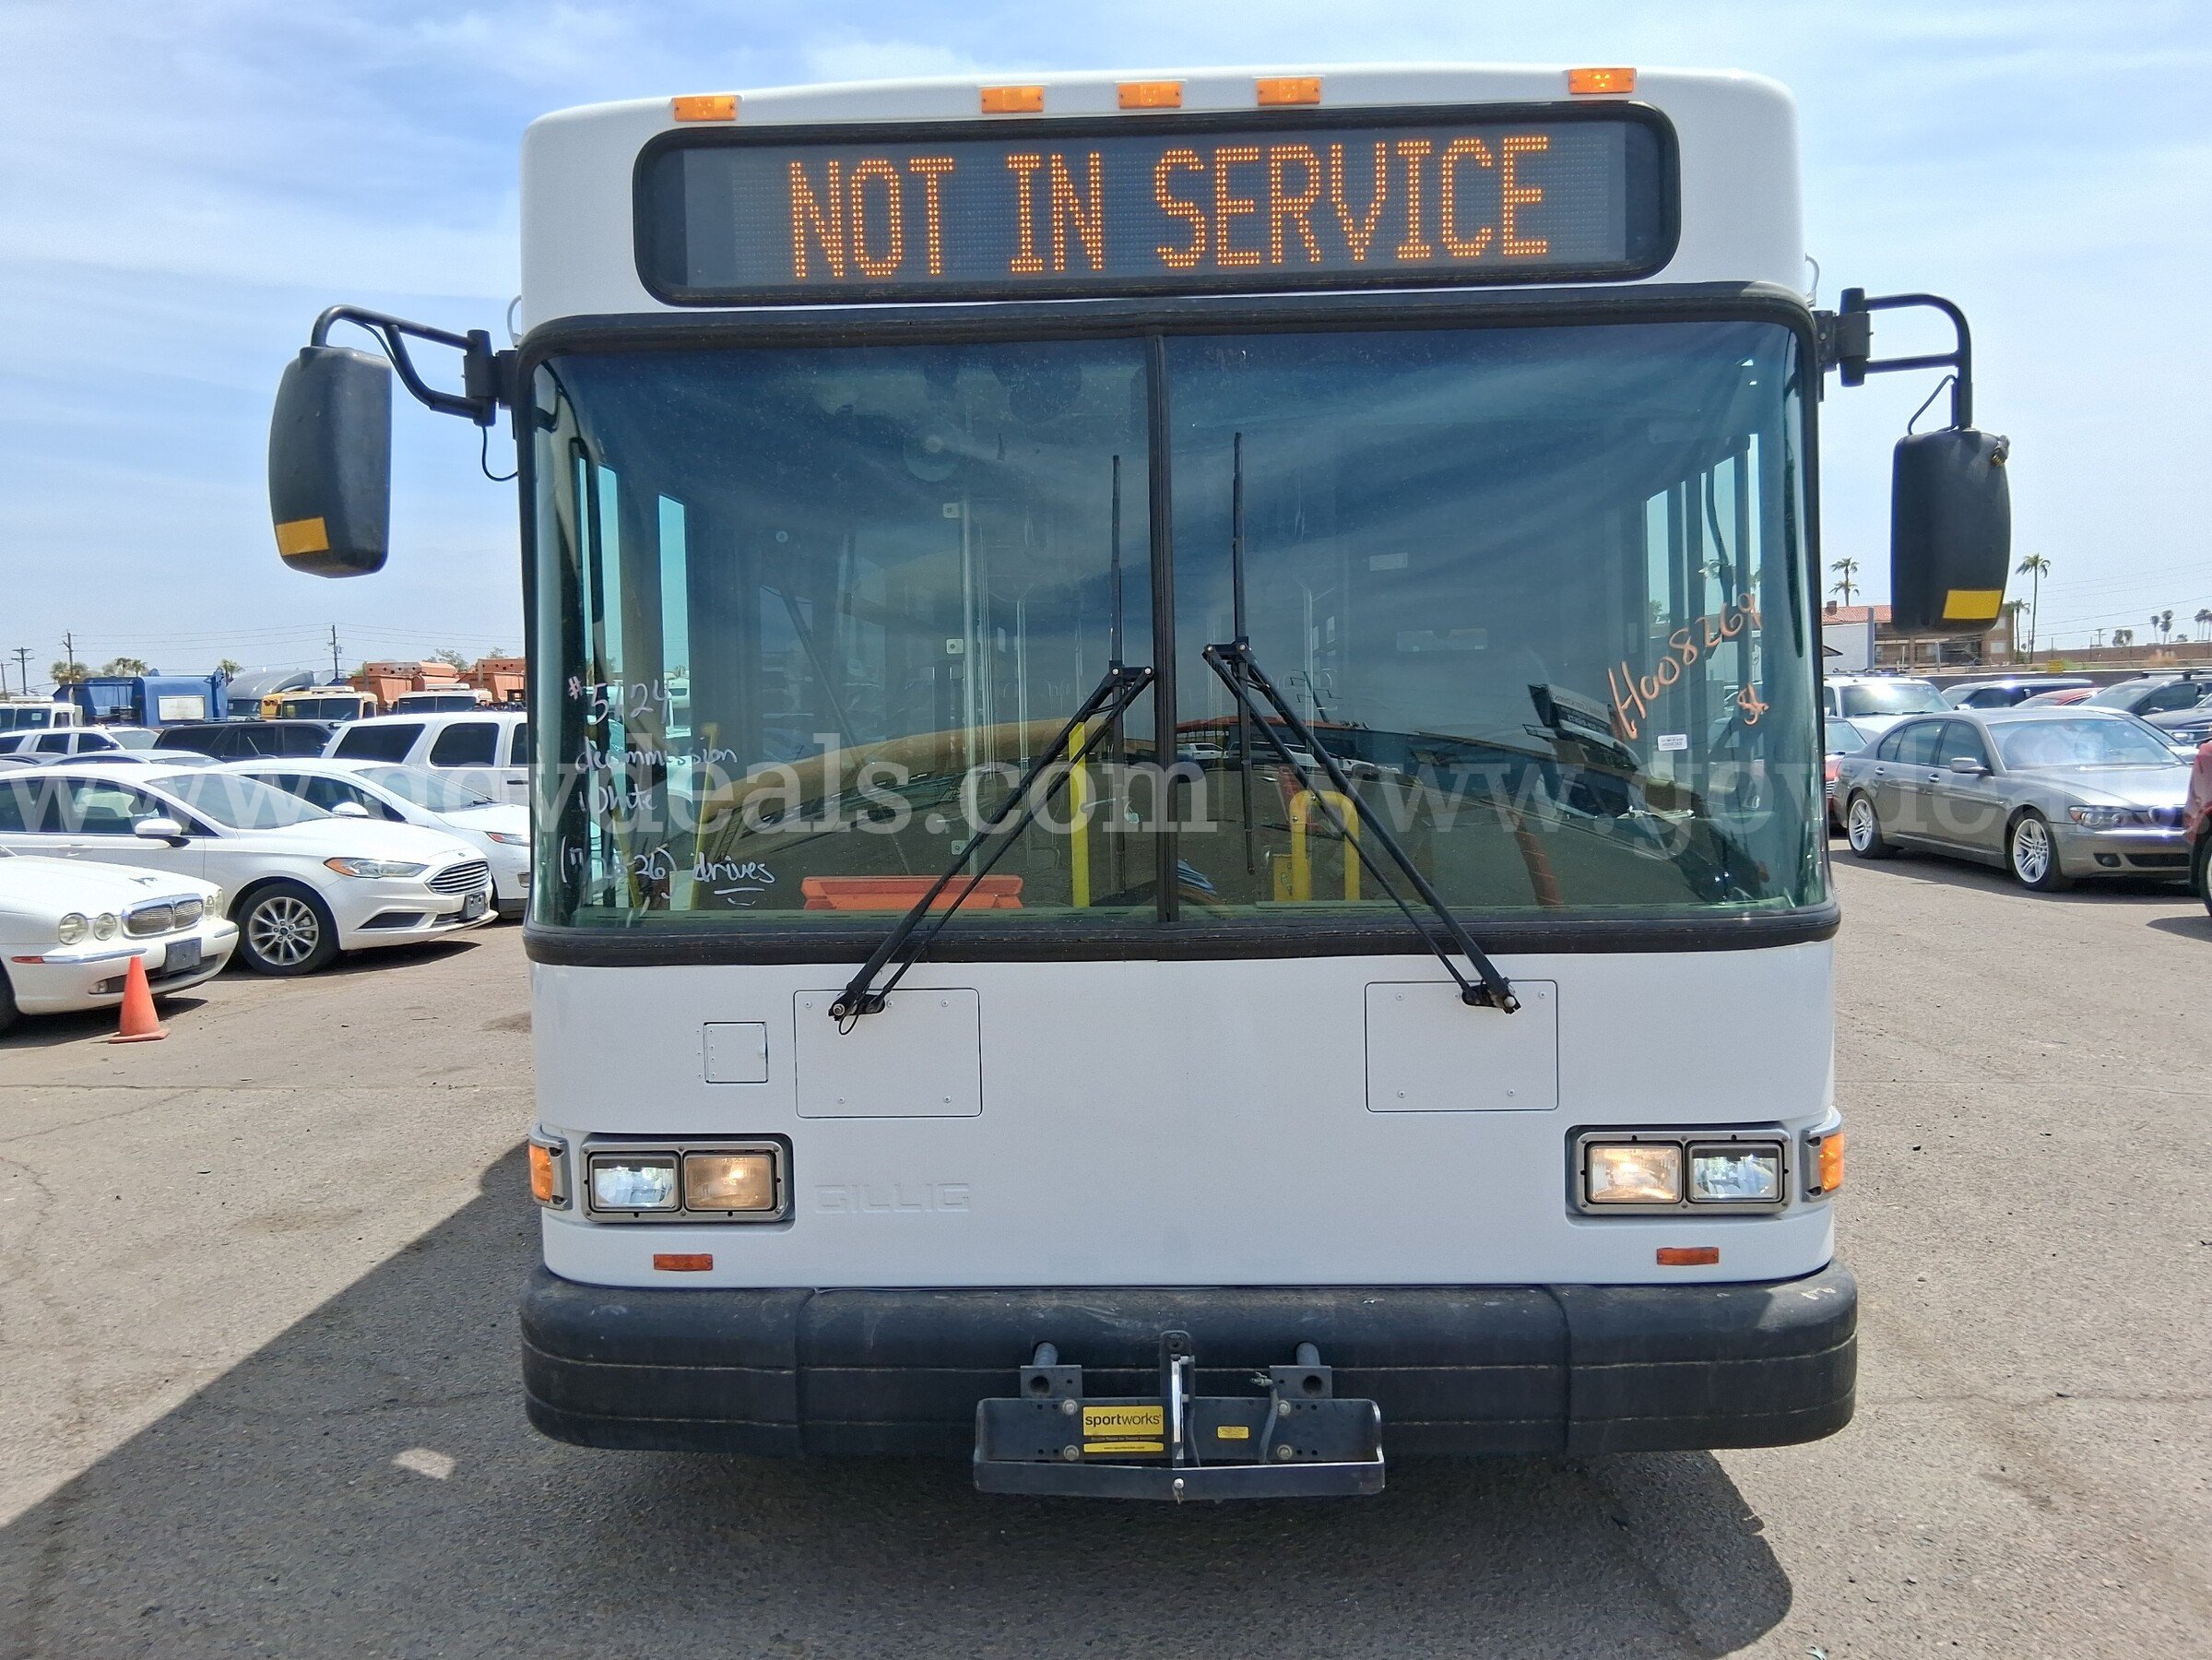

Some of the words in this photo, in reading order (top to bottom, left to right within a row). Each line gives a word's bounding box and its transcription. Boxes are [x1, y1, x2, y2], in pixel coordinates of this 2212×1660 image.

[790, 158, 954, 278] NOT
[1007, 151, 1104, 272] IN
[1154, 136, 1549, 268] SERVICE
[693, 851, 776, 883] drives
[815, 1183, 969, 1214] GILLIG
[1084, 1413, 1160, 1428] sportworks
